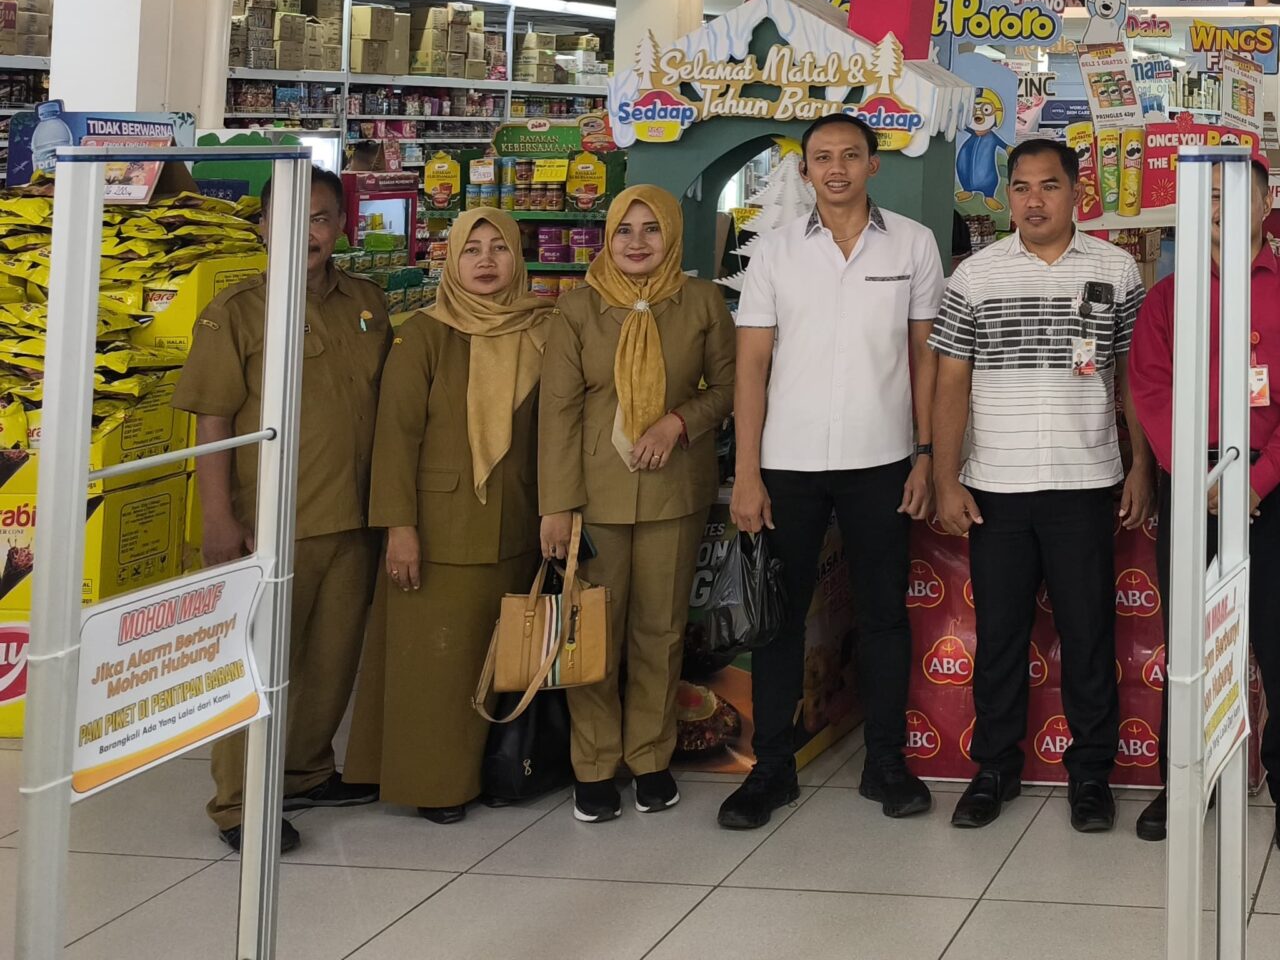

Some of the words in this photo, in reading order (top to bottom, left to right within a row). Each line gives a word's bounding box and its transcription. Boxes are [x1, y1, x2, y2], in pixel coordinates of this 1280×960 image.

[1126, 15, 1172, 38] Daia
[1189, 22, 1274, 54] WINGS
[660, 50, 755, 86] Selamat
[762, 45, 840, 85] Natal
[848, 54, 867, 84] &
[617, 100, 695, 127] Sedaap
[700, 83, 769, 119] Tahun
[775, 87, 838, 120] Baru
[87, 120, 121, 135] TIDAK
[121, 122, 174, 138] BERWARNA
[519, 135, 560, 143] RAYAKAN
[1147, 133, 1179, 147] ONCE
[1180, 133, 1205, 146] YOU
[500, 143, 577, 153] KEBERSAMAAN
[1147, 157, 1168, 170] THE
[118, 597, 178, 646] MOHON
[177, 581, 226, 626] MAAF
[91, 657, 125, 686] Jika
[128, 641, 173, 670] Alarm
[174, 613, 237, 654] Berbunyi
[106, 665, 159, 699] Mohon
[160, 639, 221, 684] Hubungi
[928, 658, 970, 676] ABC
[78, 716, 104, 748] PAM
[104, 703, 137, 737] PIKET
[137, 699, 150, 722] DI
[203, 658, 246, 691] BARANG
[98, 728, 141, 755] Barangkali
[141, 724, 158, 737] Ada
[158, 714, 178, 733] Yang
[177, 706, 196, 722] Lalai
[196, 699, 213, 713] dari
[212, 691, 231, 707] Kami
